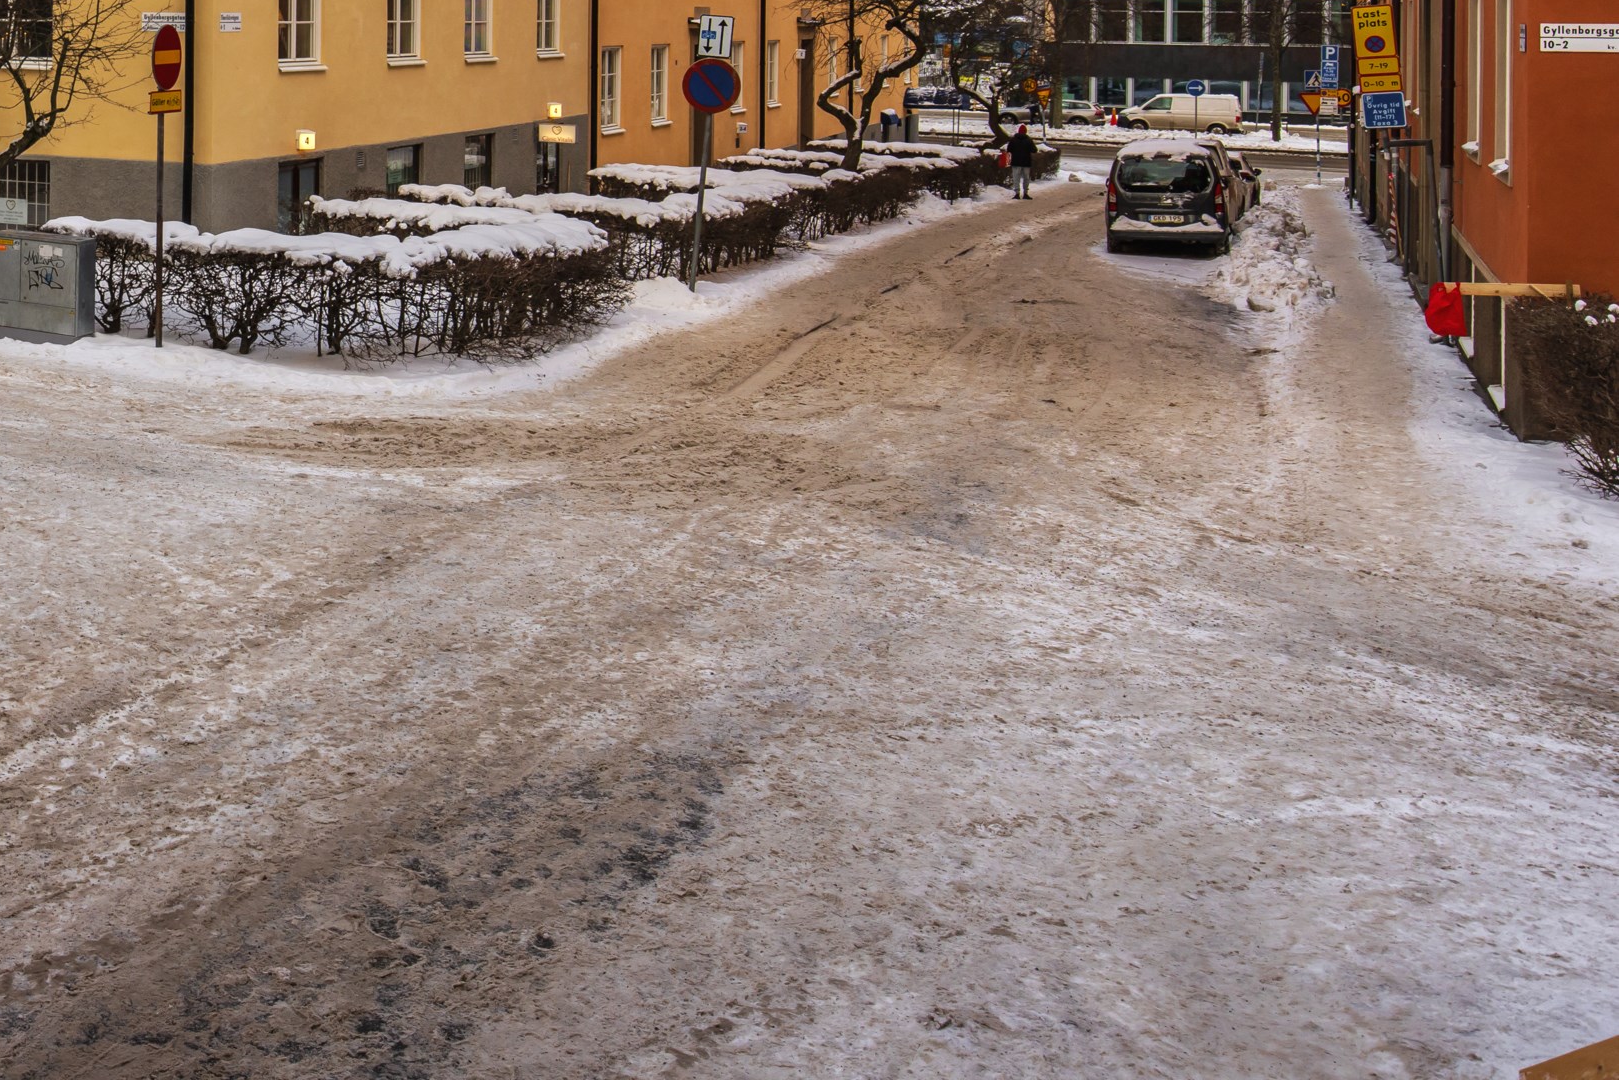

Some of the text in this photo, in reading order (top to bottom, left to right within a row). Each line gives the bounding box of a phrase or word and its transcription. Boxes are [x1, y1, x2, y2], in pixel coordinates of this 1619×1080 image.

[1357, 10, 1387, 18] Last-
[1358, 20, 1387, 30] plats
[1543, 41, 1569, 49] 10-2
